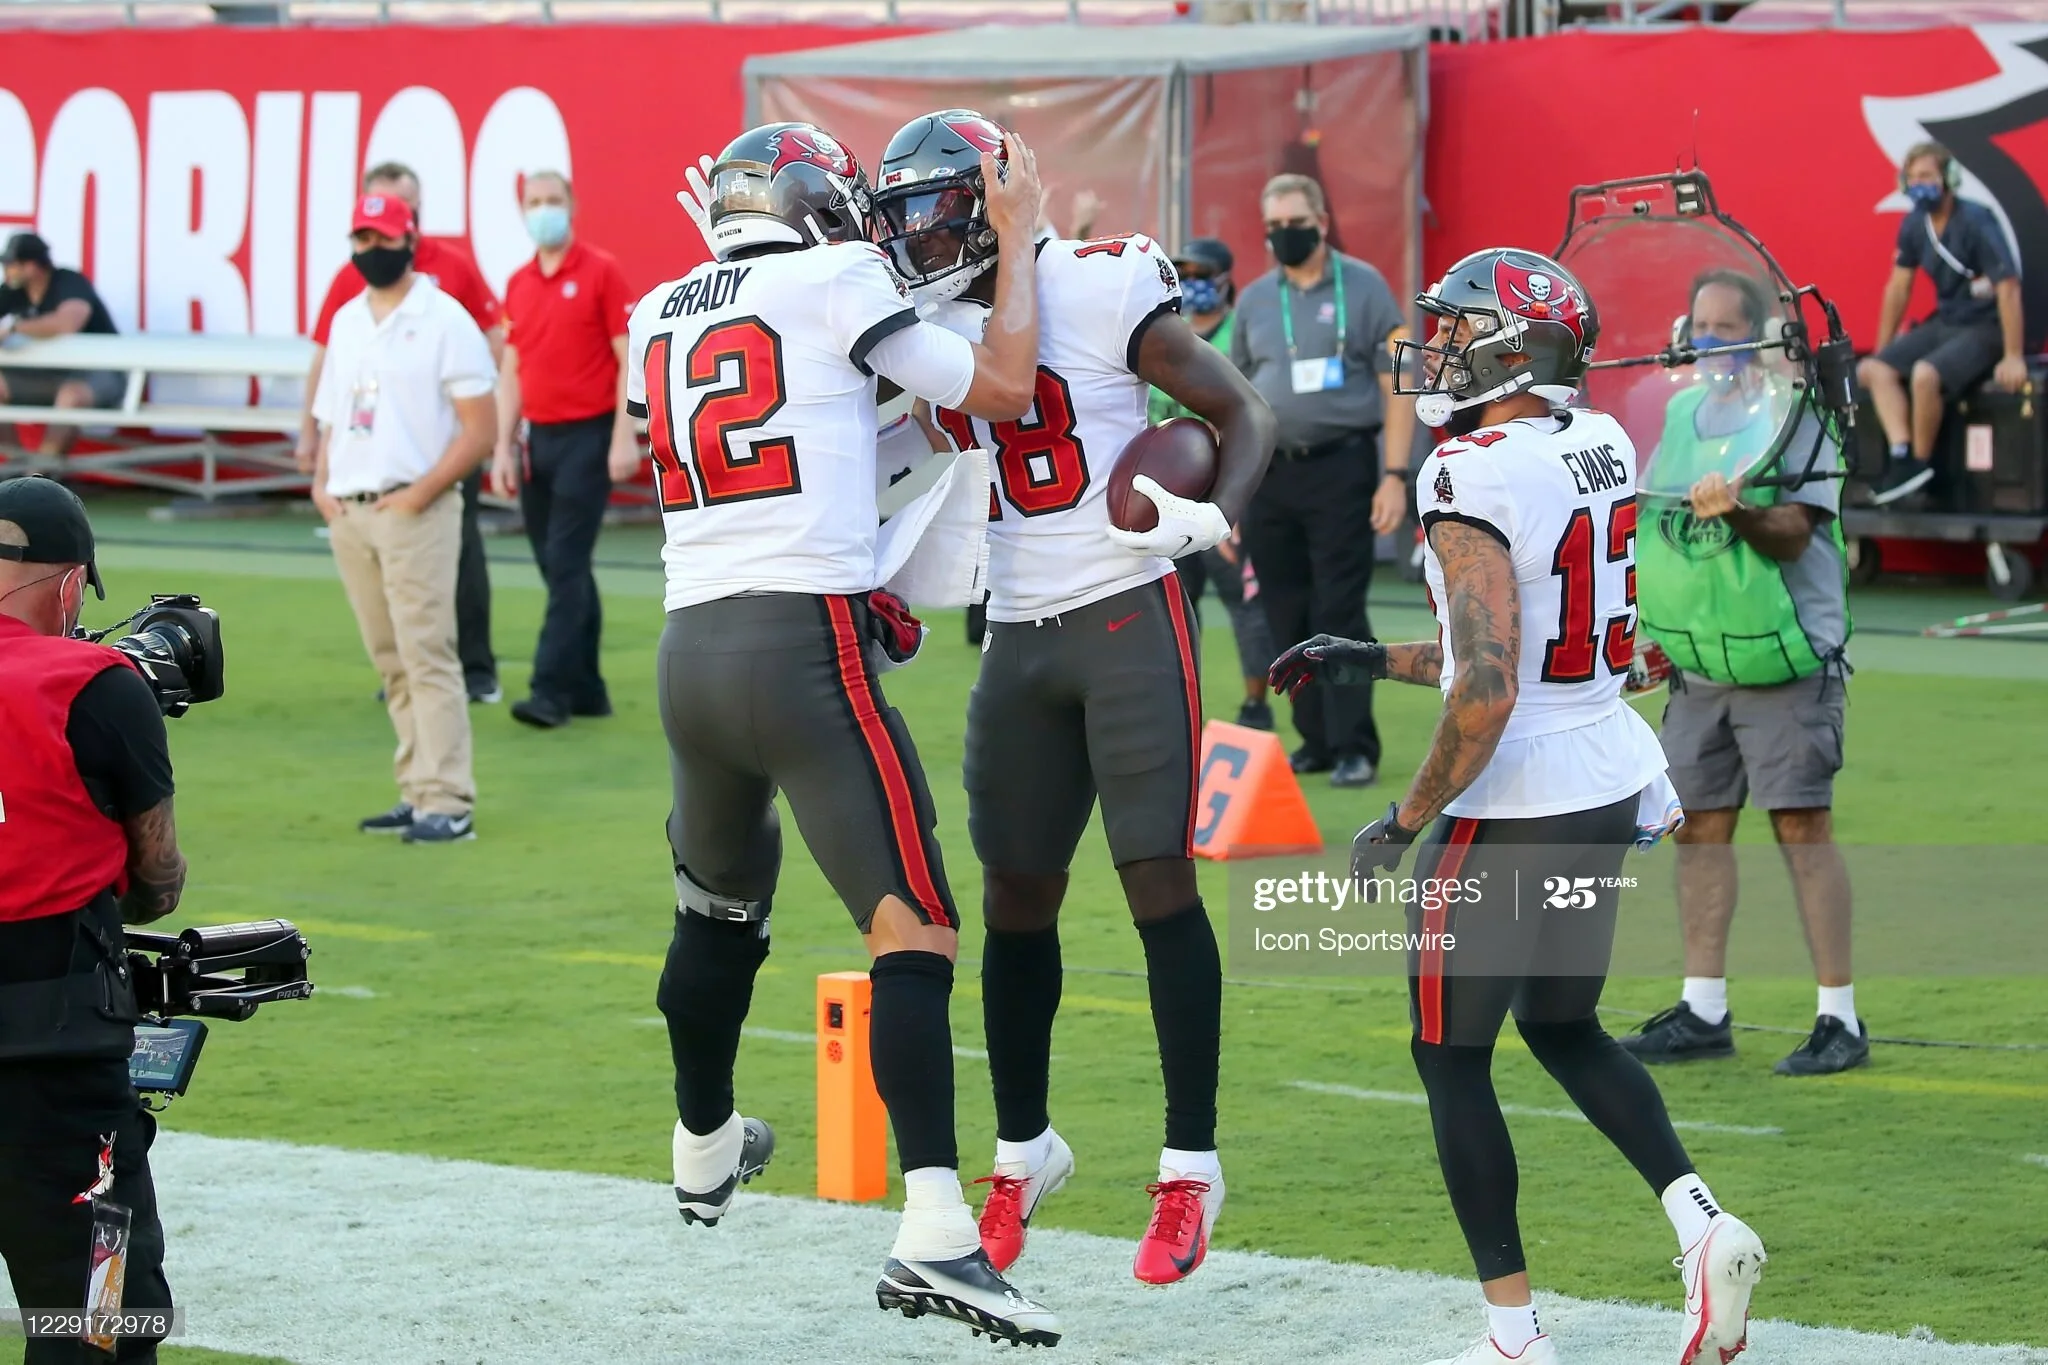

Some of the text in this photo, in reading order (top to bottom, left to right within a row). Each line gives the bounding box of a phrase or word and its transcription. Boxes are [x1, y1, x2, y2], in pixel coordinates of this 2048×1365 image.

[660, 267, 752, 319] BRADY
[644, 314, 802, 513] 12
[1561, 444, 1628, 495] EVANS
[1541, 495, 1638, 683] 13
[1194, 743, 1250, 846] G
[277, 989, 300, 999] PRO
